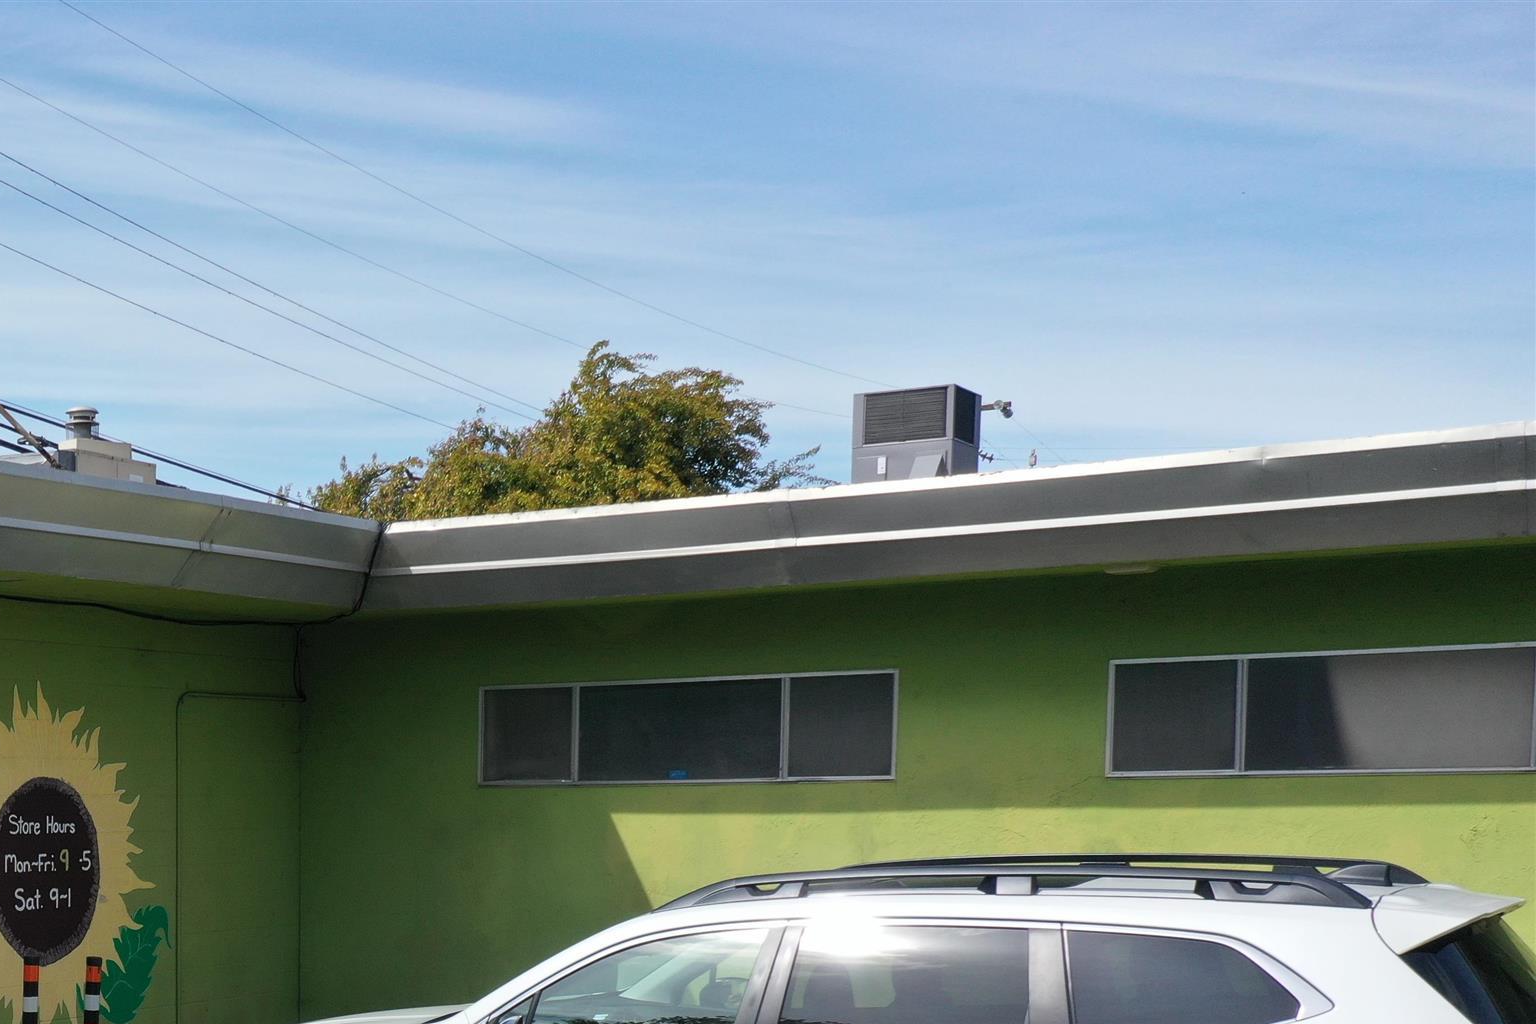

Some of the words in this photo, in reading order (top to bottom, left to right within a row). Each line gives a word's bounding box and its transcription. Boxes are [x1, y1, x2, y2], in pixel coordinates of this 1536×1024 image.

[8, 814, 41, 835] Store
[46, 815, 76, 834] Hours
[14, 887, 44, 912] Sat.
